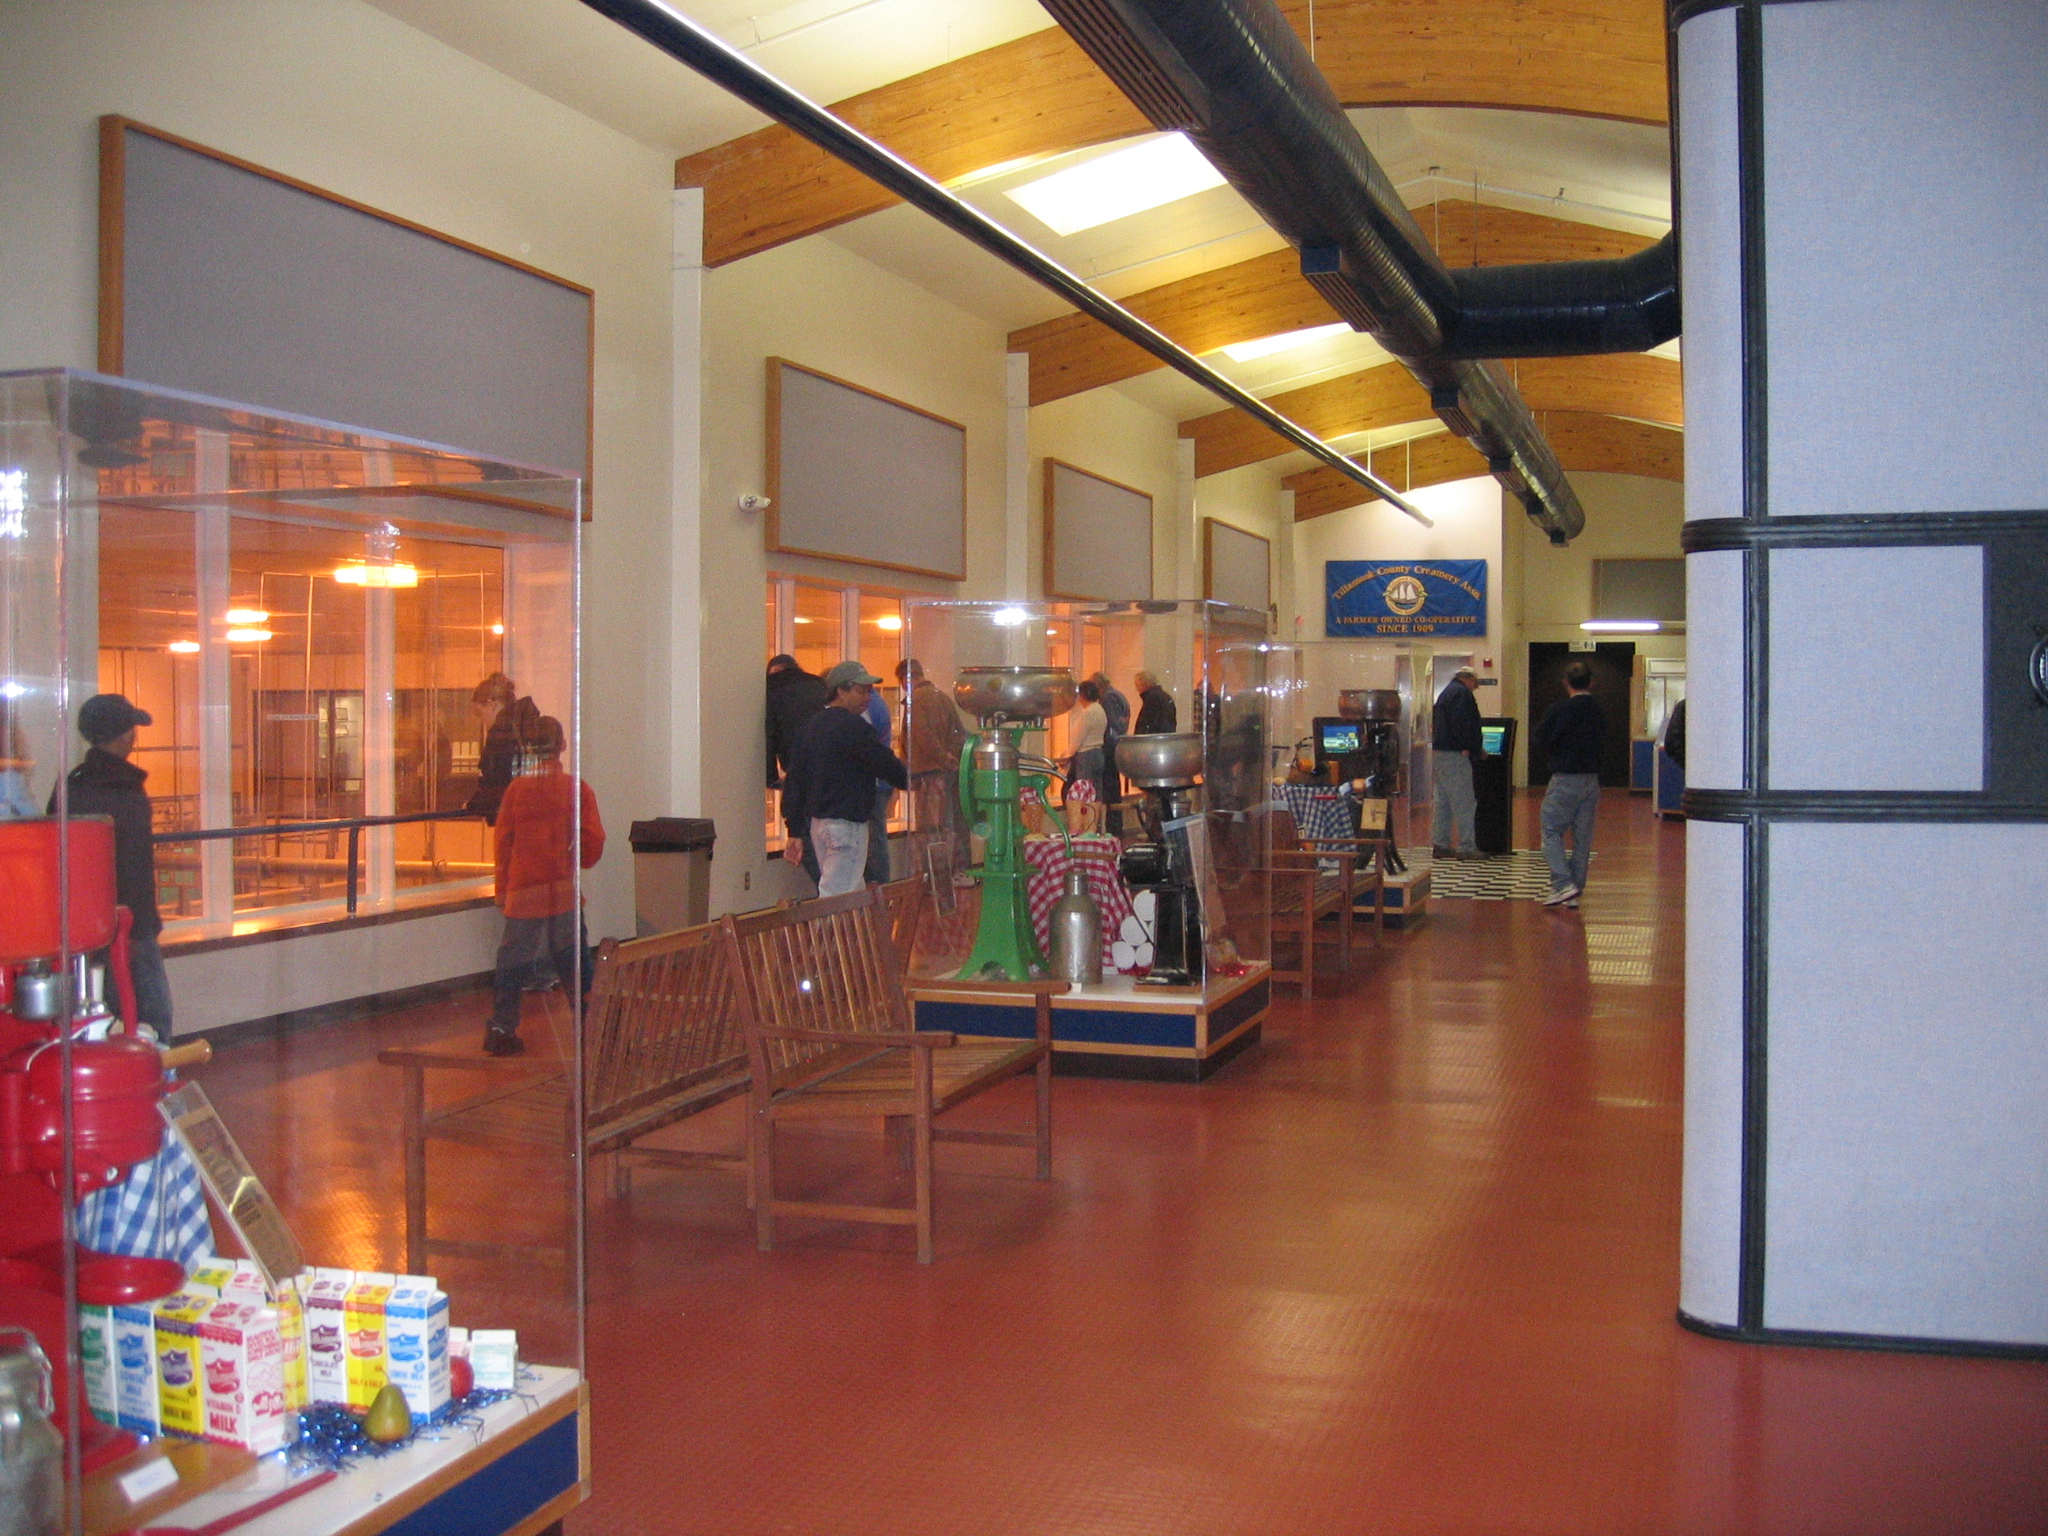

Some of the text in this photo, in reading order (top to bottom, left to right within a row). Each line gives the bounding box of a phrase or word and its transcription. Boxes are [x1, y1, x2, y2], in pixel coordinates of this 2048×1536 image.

[1333, 570, 1376, 599] Tillamook
[1377, 566, 1411, 575] County
[1414, 565, 1460, 584] Creamery
[1344, 616, 1378, 624] FARMER
[1376, 624, 1434, 633] SINCE 1909
[210, 1412, 238, 1434] MILK
